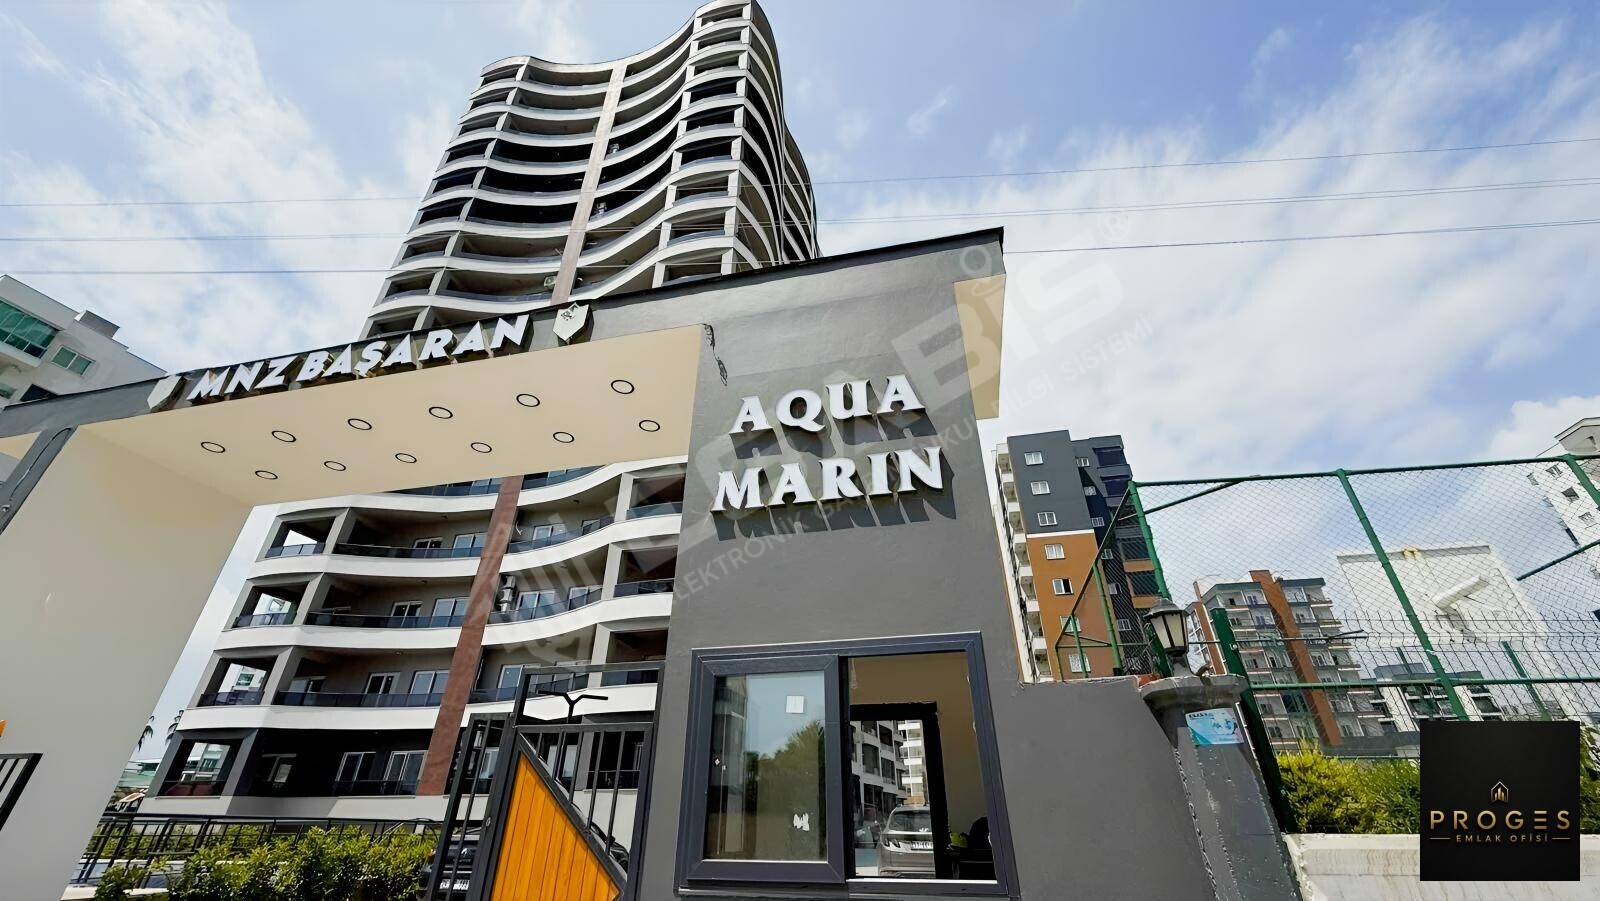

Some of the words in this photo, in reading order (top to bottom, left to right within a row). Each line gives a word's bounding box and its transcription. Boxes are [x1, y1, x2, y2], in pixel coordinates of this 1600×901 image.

[187, 357, 297, 400] MNZ
[297, 315, 530, 382] BAŞARAN
[729, 374, 925, 434] AQUA
[711, 446, 943, 512] MARIN
